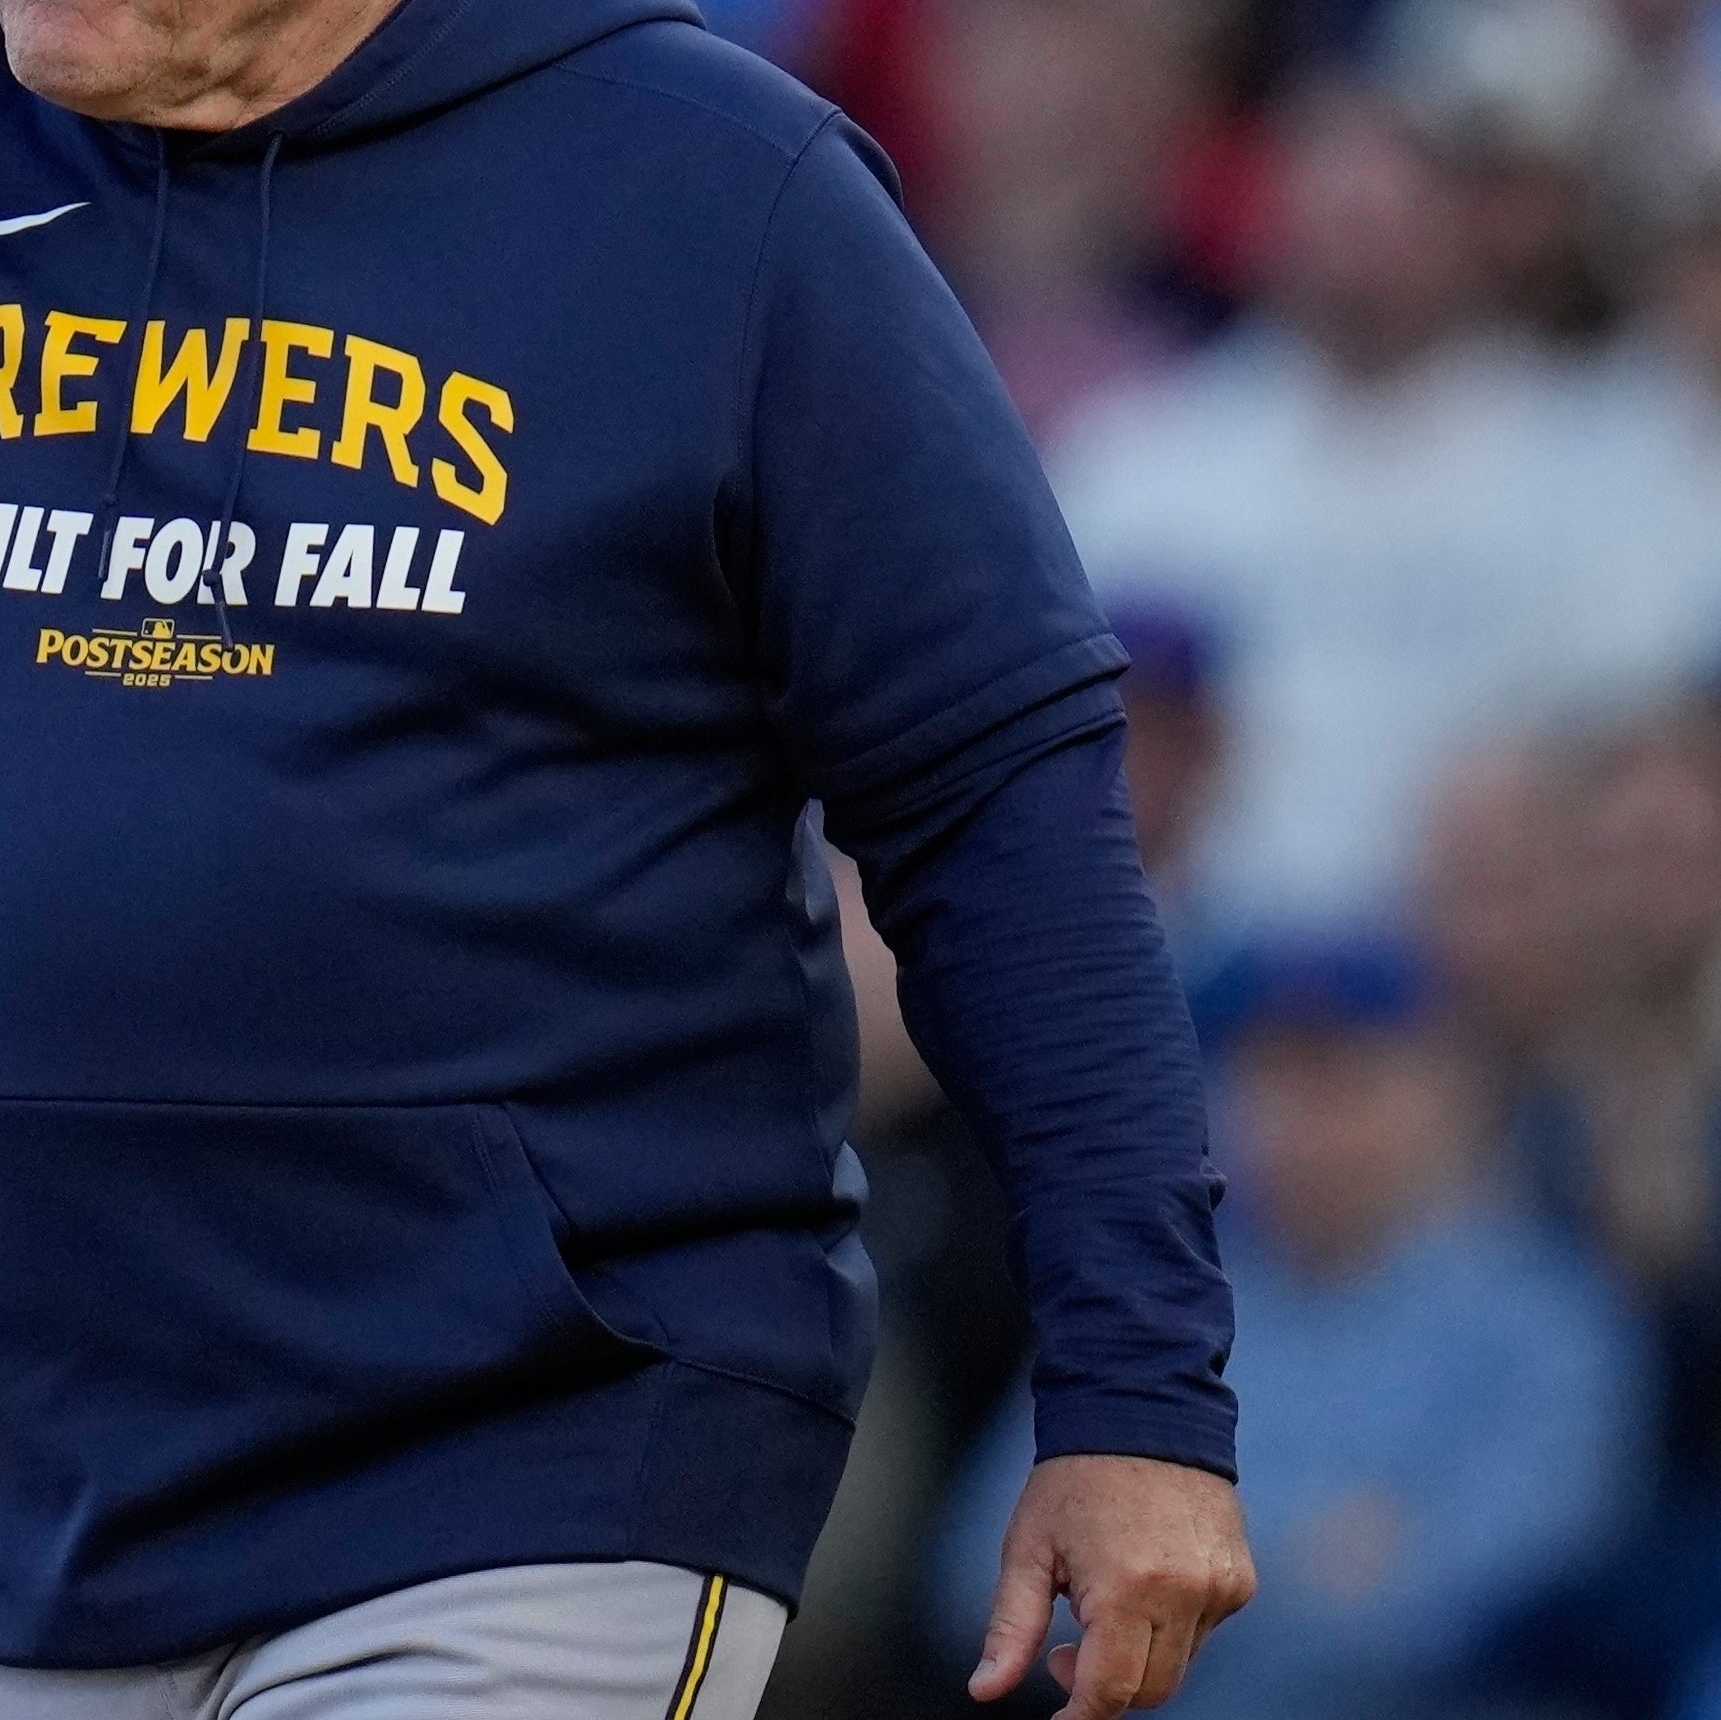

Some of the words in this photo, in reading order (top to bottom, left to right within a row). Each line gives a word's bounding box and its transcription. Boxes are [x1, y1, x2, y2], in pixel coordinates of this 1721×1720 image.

[100, 516, 257, 607] FOR
[274, 522, 467, 615] FALL
[36, 628, 275, 676] POSTSEASON
[122, 673, 172, 688] 2025
